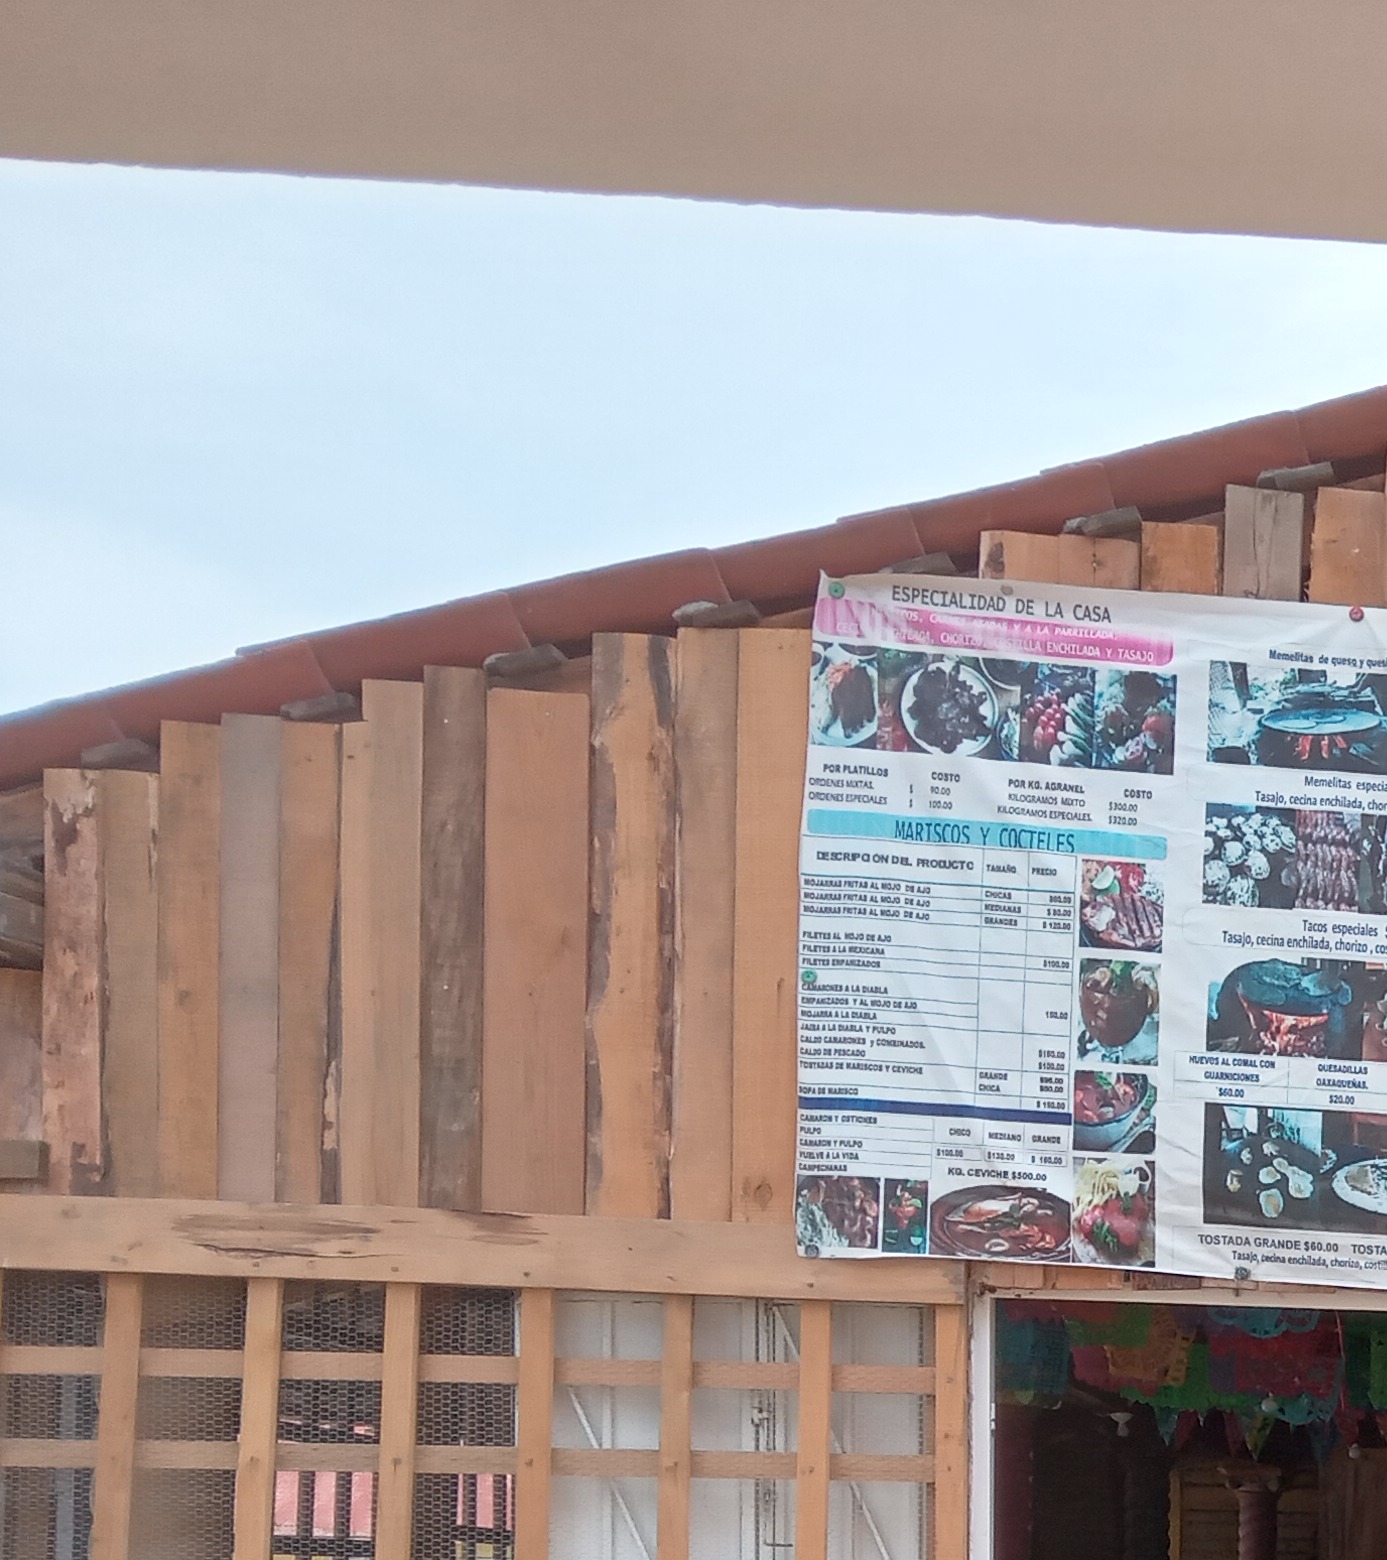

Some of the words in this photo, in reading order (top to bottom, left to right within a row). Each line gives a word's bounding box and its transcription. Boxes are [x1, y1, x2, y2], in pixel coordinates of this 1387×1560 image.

[891, 583, 1006, 612] ESPECIALIDAD
[1014, 597, 1035, 616] DE
[1044, 600, 1064, 618] LA
[1072, 603, 1111, 623] CASA
[1046, 639, 1101, 657] ENCHILADA
[1105, 647, 1112, 658] Y
[1117, 647, 1155, 663] TASAJO
[1268, 648, 1314, 663] Memelitas
[1317, 653, 1329, 664] de
[1330, 656, 1358, 667] queso
[1358, 658, 1365, 669] y
[822, 763, 841, 773] POR
[842, 763, 888, 777] PLATILLOS
[930, 770, 960, 783] COSTO
[1303, 775, 1352, 789] Memelitas
[1255, 790, 1287, 806] Tasajo,
[1288, 793, 1317, 806] cecina
[1318, 794, 1365, 811] enchilada,
[998, 826, 1075, 853] COCTELES
[1302, 918, 1328, 933] Tacos
[1331, 922, 1378, 937] especiales
[1221, 929, 1254, 947] Tasajo,
[1255, 933, 1284, 947] cecina
[1285, 935, 1332, 952] enchilada,
[1333, 937, 1368, 953] chorizo
[1188, 1055, 1219, 1065] HUEVOS
[1220, 1057, 1231, 1066] AL
[1231, 1057, 1258, 1068] COMAL
[1258, 1059, 1275, 1069] CON
[1316, 1063, 1368, 1075] QUESADILLAS
[1196, 1233, 1251, 1246] TOSTADA
[1253, 1236, 1301, 1250] GRANDE
[1303, 1240, 1339, 1252] $60.00
